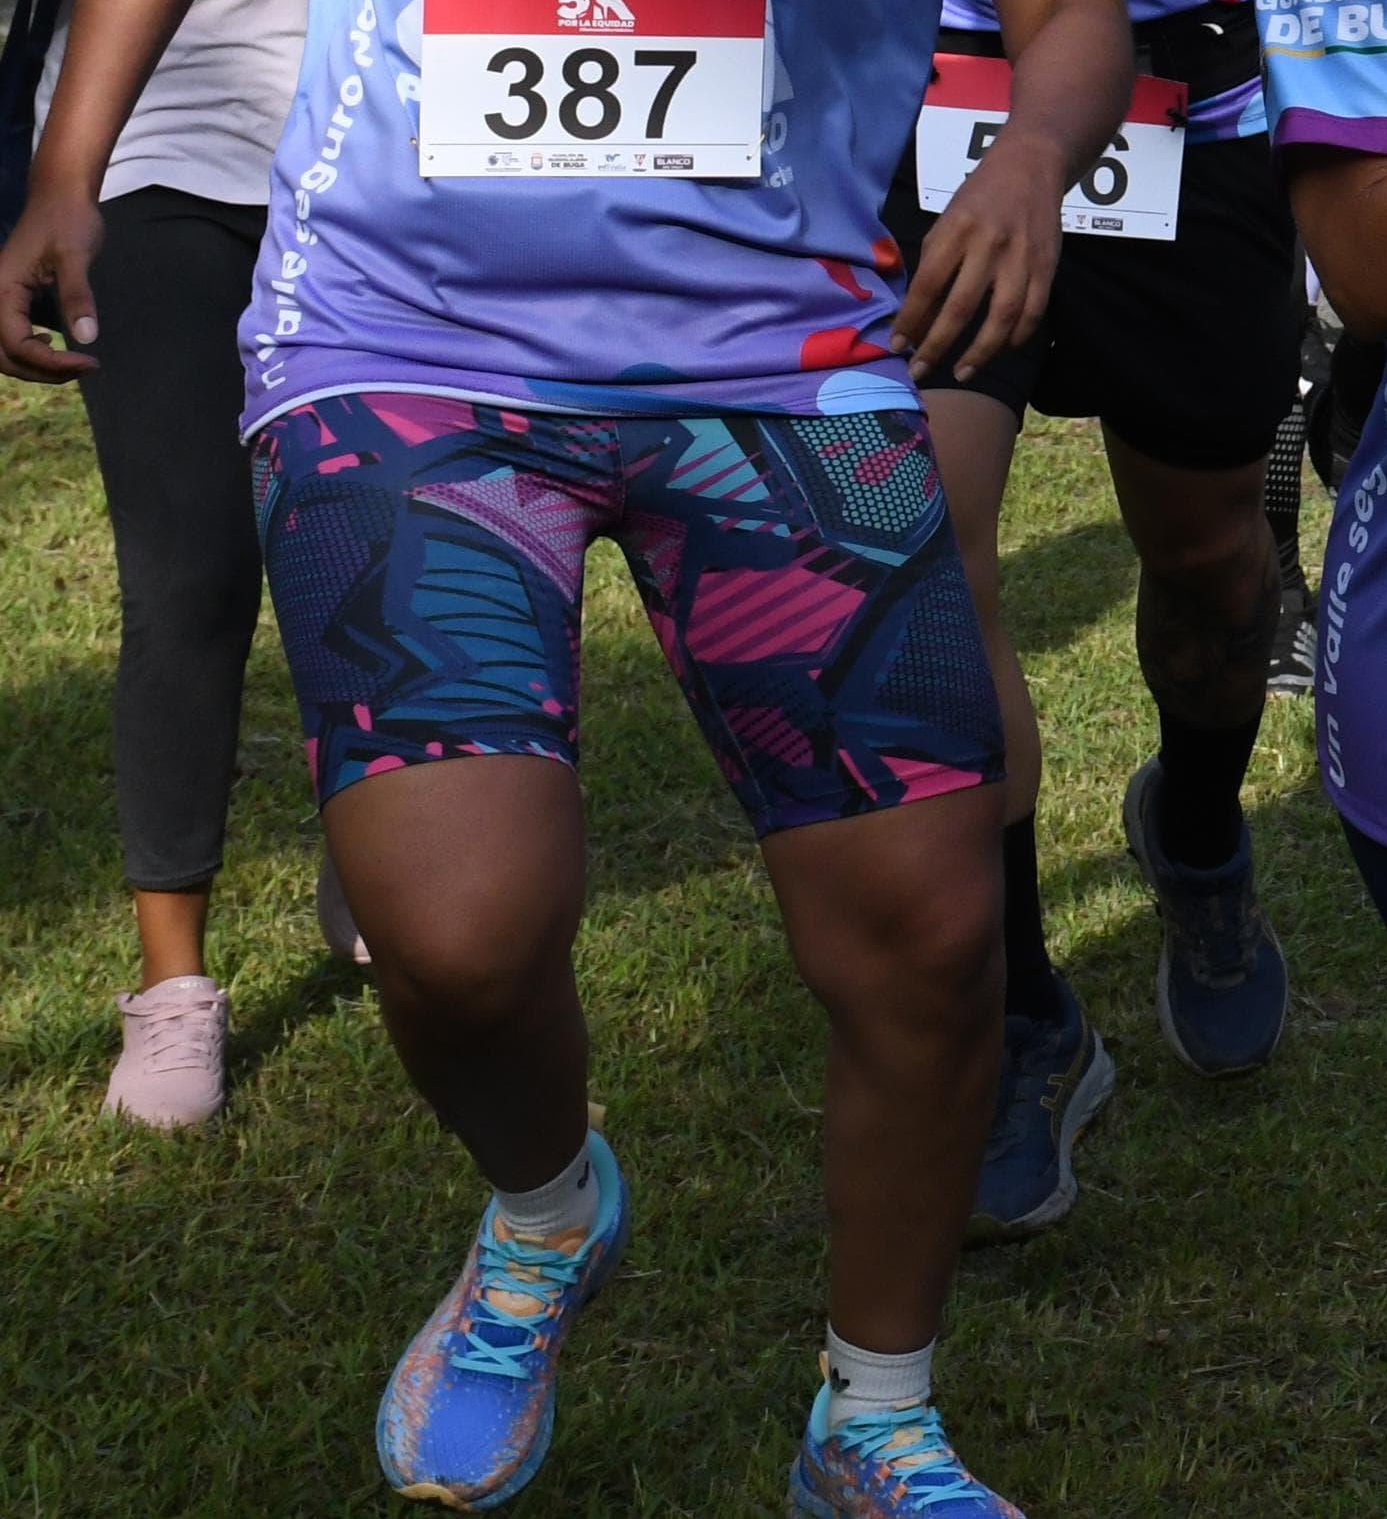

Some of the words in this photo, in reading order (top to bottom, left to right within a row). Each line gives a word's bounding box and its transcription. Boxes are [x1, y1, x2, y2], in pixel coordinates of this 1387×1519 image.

[1266, 6, 1325, 45] DE
[484, 46, 698, 141] 387
[294, 75, 364, 245] seguro
[1322, 561, 1354, 696] Valle
[1327, 712, 1346, 789] Un
